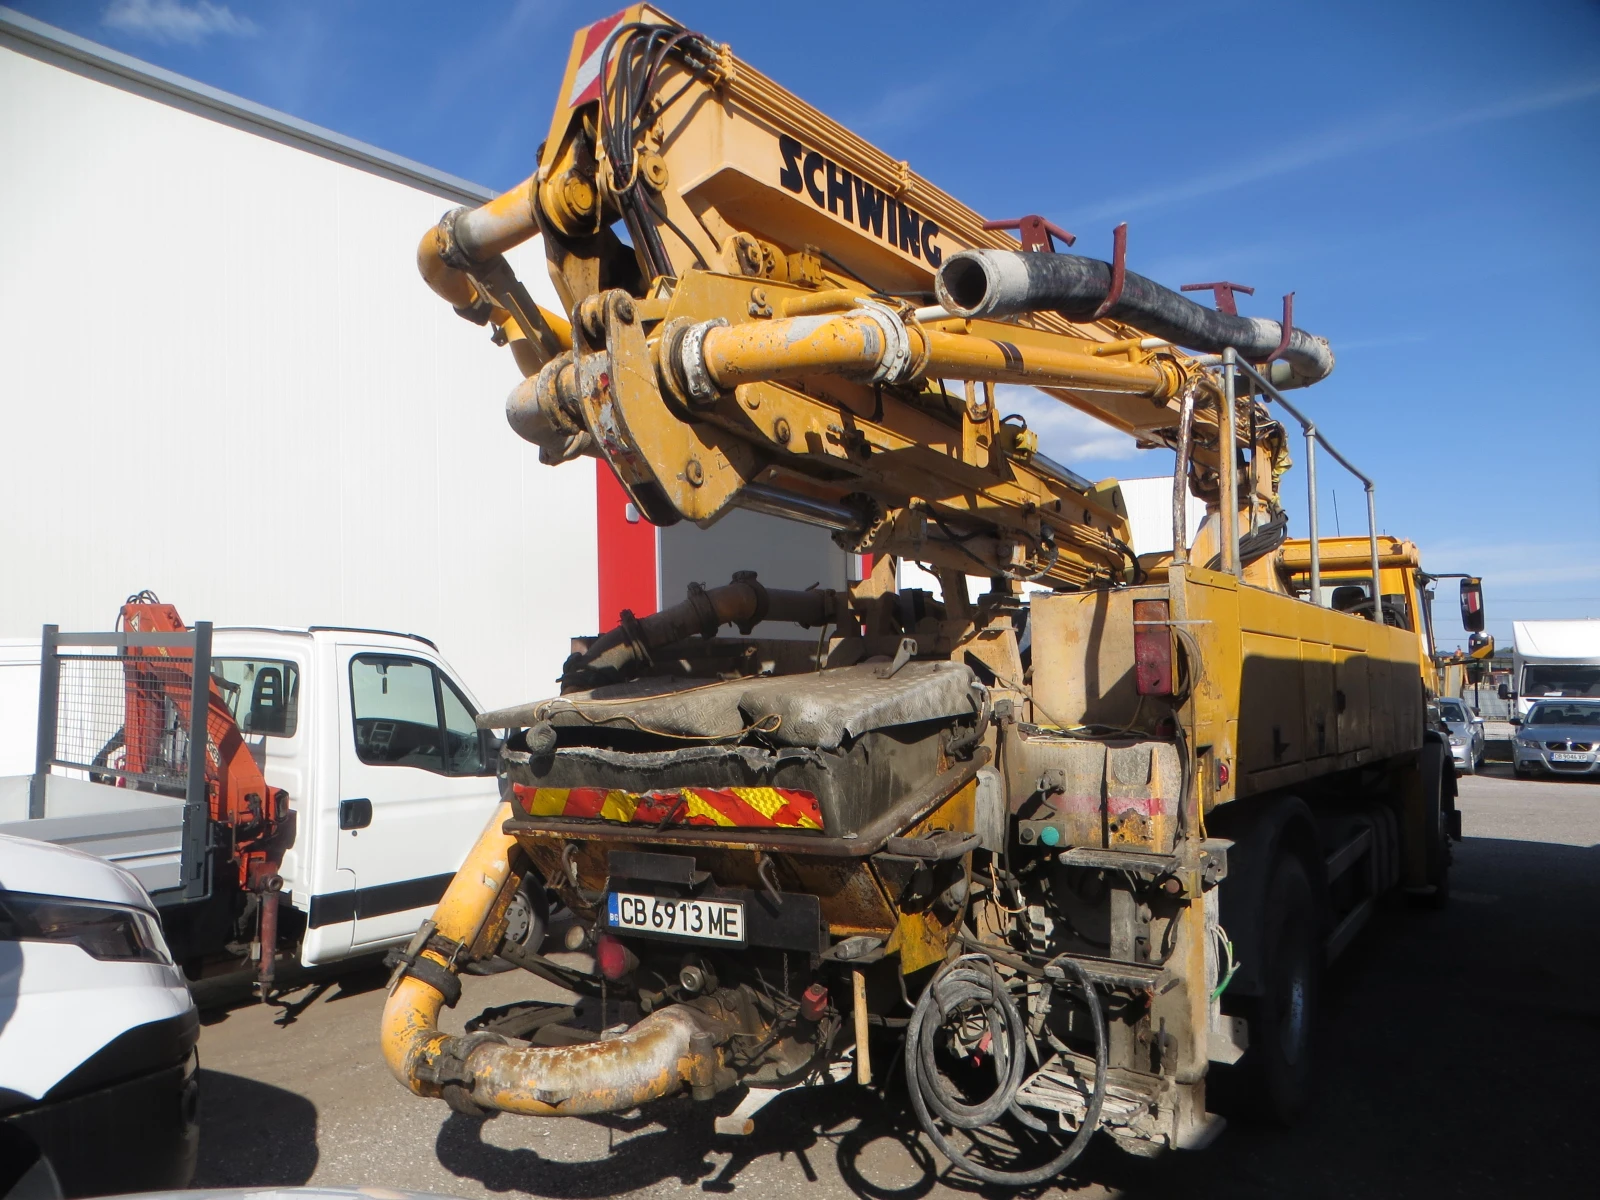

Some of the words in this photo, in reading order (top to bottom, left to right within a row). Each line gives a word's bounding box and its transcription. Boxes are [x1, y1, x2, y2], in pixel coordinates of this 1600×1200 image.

[779, 134, 942, 269] SCHWING
[609, 912, 619, 921] BG
[621, 897, 647, 926] CB
[652, 900, 703, 932] 6913
[708, 906, 738, 937] ME
